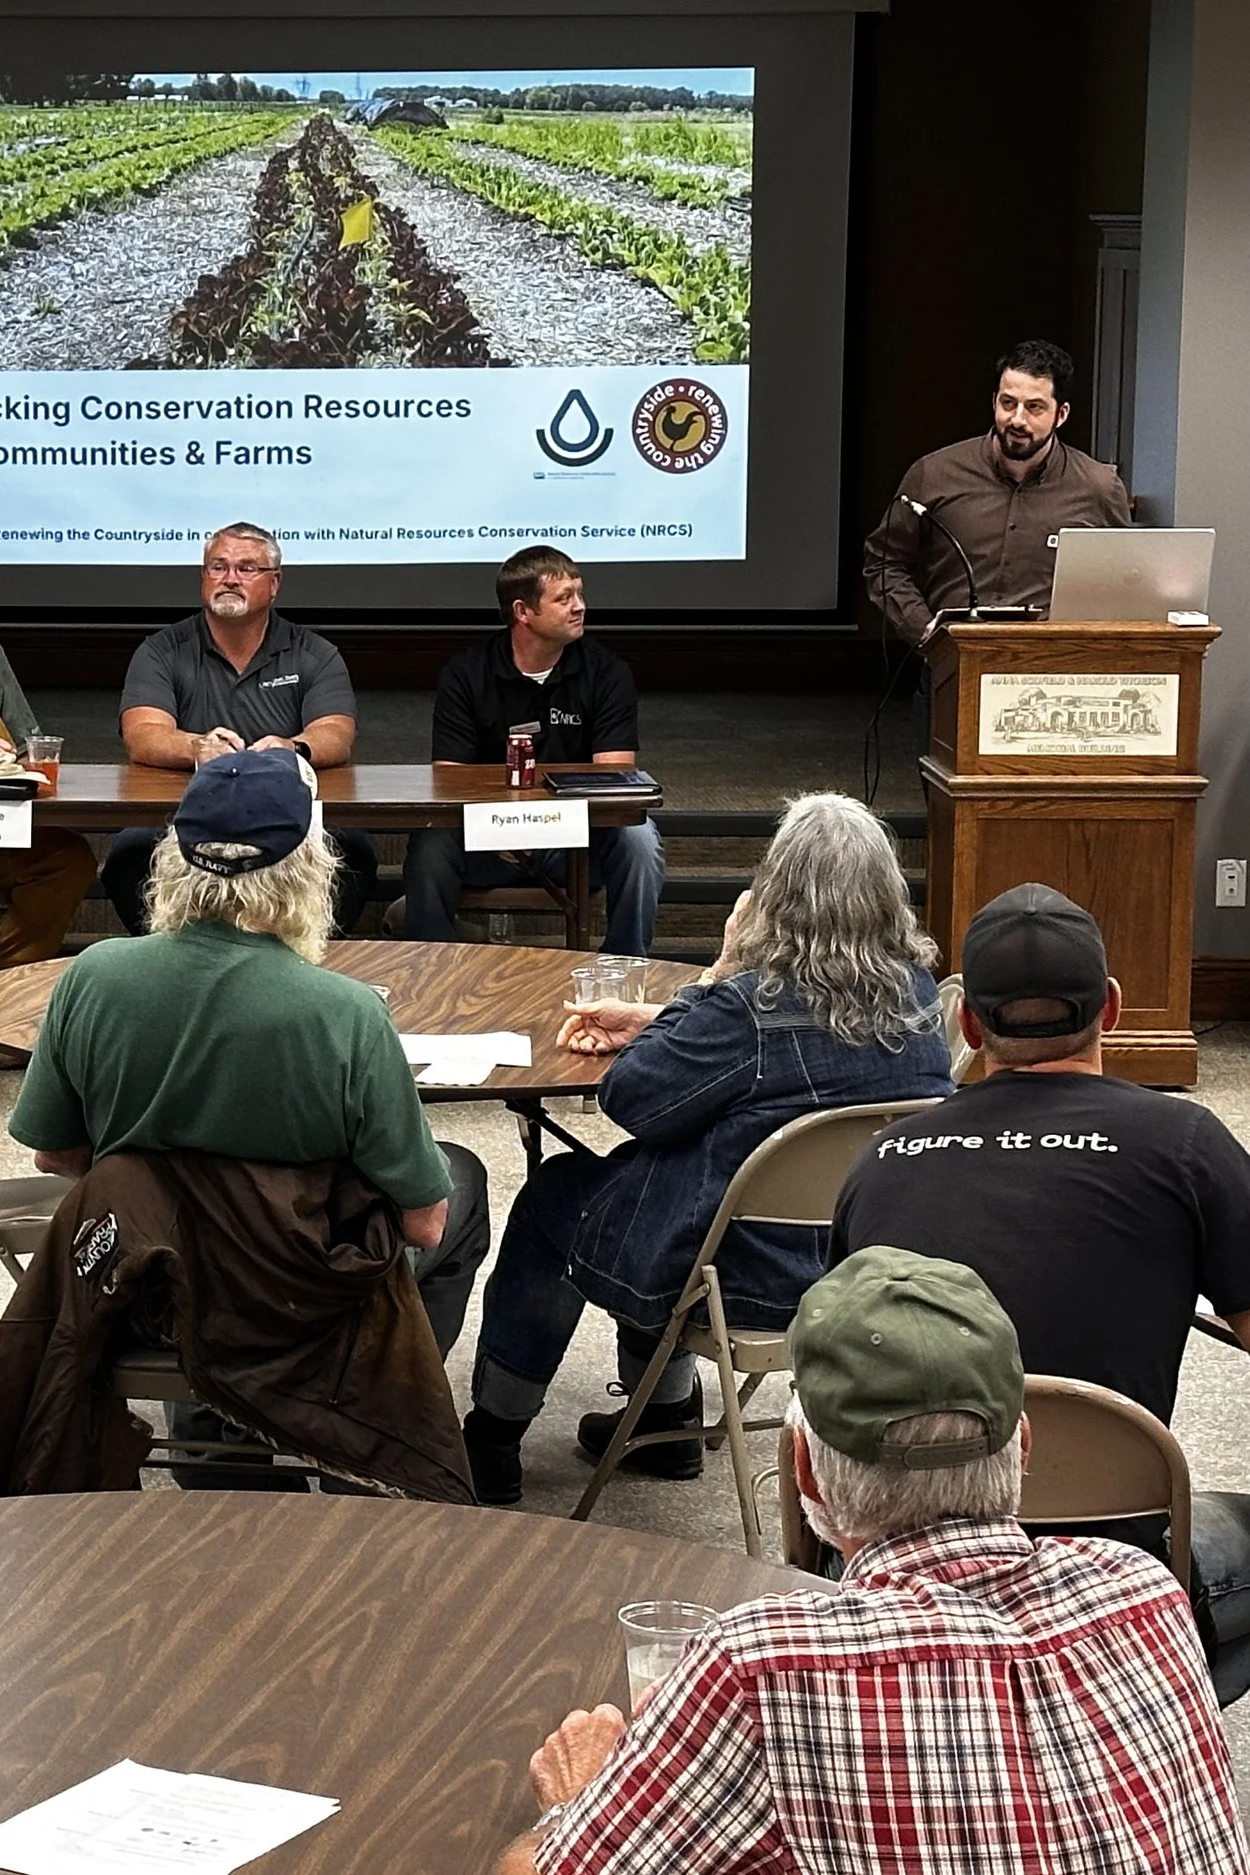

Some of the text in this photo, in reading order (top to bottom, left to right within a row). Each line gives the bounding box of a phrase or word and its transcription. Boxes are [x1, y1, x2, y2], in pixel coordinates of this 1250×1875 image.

[81, 393, 293, 420] Conservation
[304, 394, 471, 419] Resources
[636, 384, 723, 470] renewing the countryside
[185, 441, 205, 465] &
[216, 440, 312, 465] Farms
[67, 528, 90, 540] the
[94, 528, 183, 543] Countryside
[187, 528, 200, 540] in
[304, 527, 335, 540] with
[339, 527, 392, 540] Natural
[397, 526, 474, 540] Resources
[478, 525, 577, 538] Conservation
[581, 525, 636, 538] Service
[641, 523, 693, 538] (NRCS)
[492, 811, 561, 827] Ryan Haspel
[877, 1131, 1118, 1159] figure it out.
